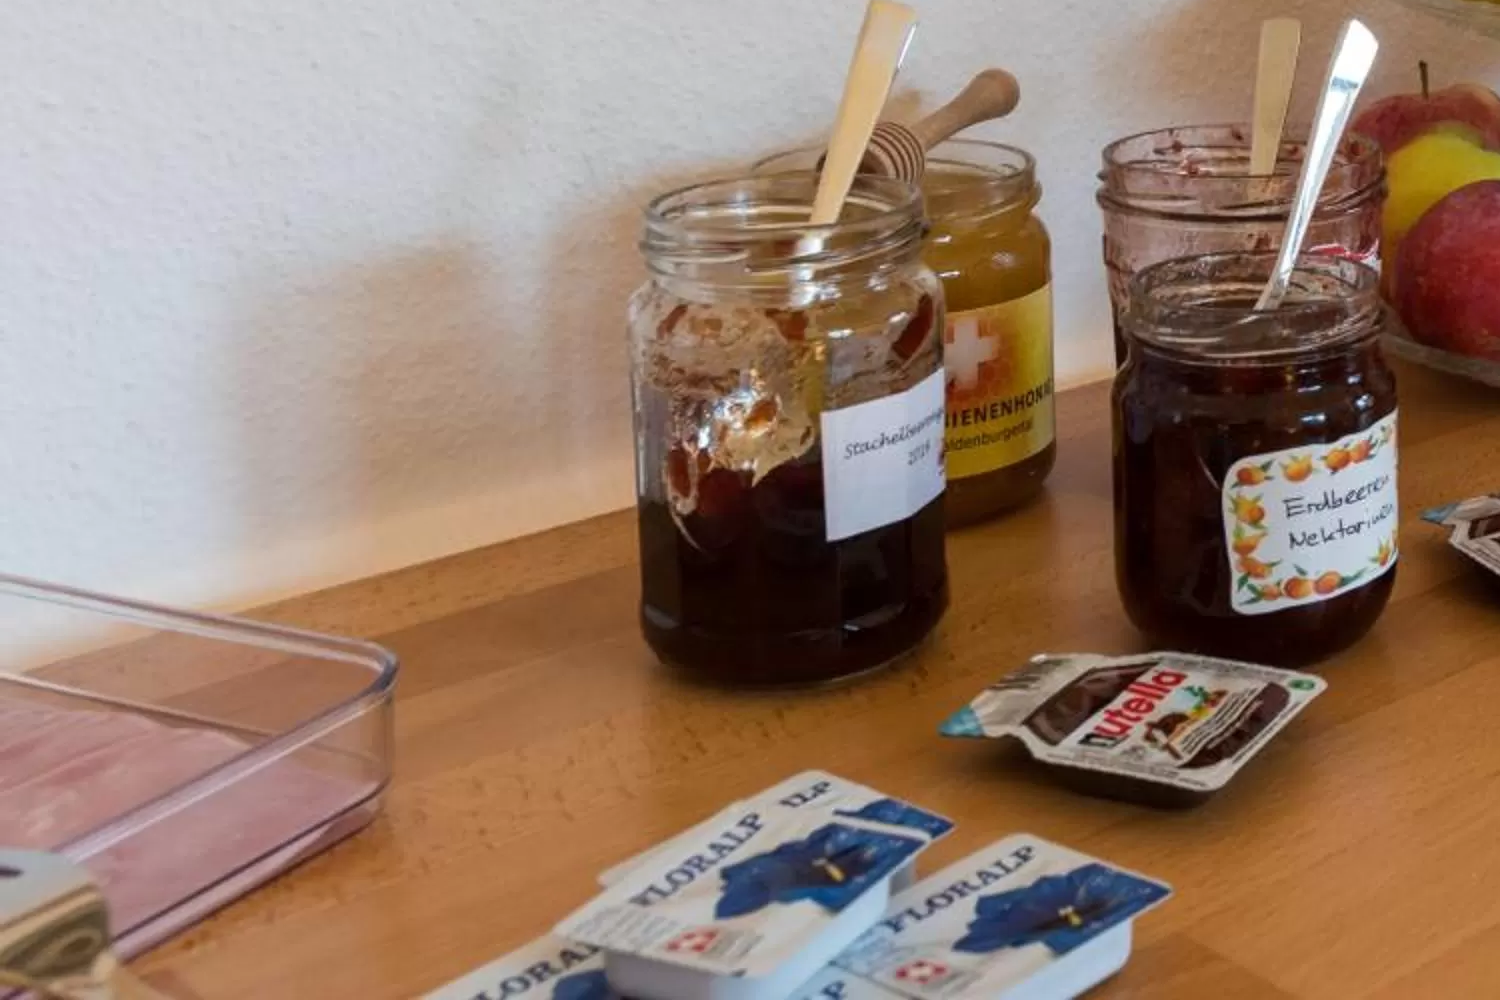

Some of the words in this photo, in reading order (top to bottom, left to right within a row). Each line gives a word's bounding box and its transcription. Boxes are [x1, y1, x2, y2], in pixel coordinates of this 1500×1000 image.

[1077, 670, 1187, 748] nutella
[630, 812, 763, 906] FLORALP
[882, 844, 1036, 934] FLORALP
